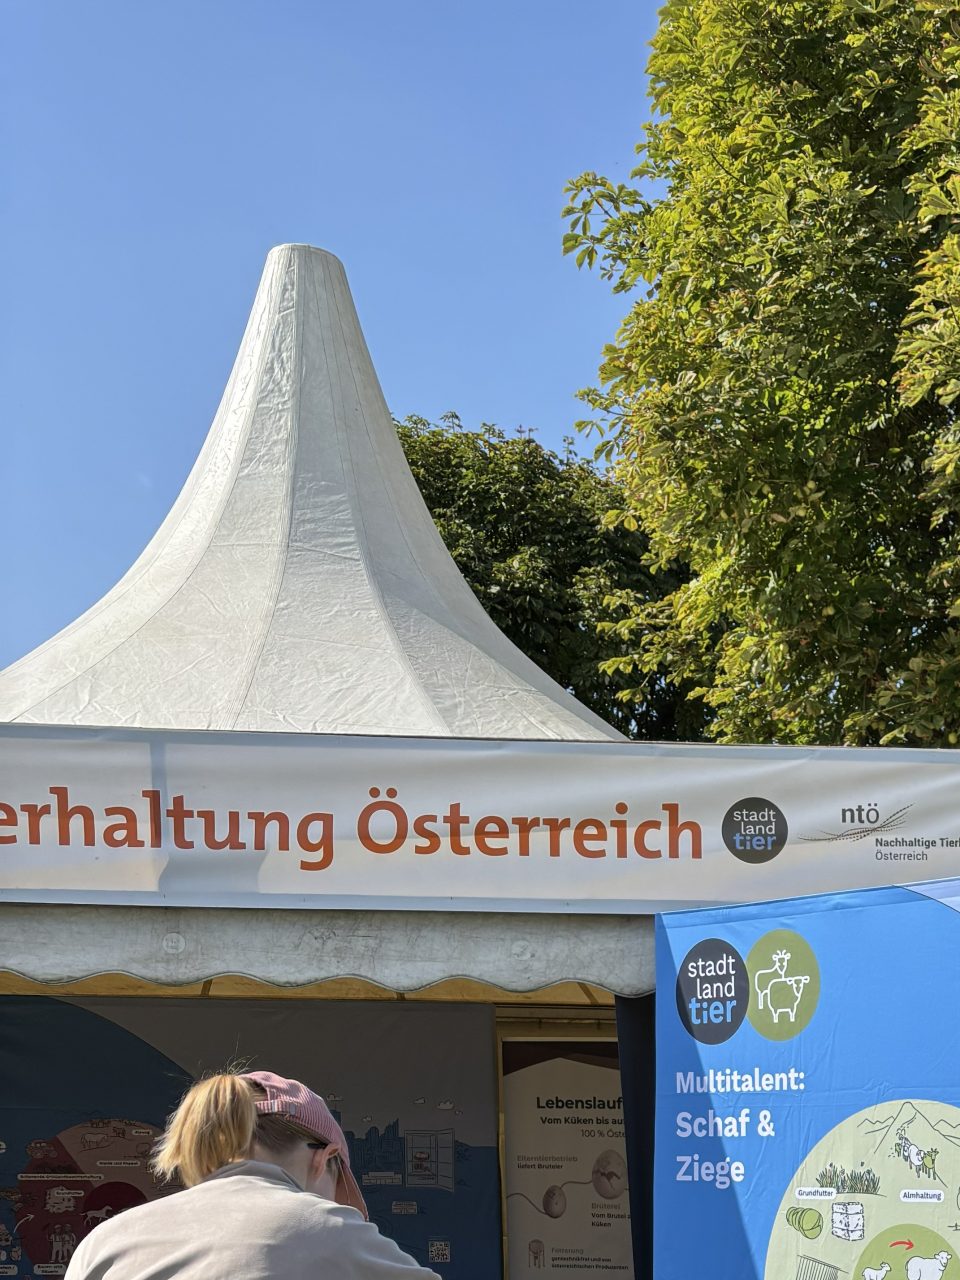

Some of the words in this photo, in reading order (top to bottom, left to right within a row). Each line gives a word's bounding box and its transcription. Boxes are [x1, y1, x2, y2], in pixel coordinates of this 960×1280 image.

[356, 786, 703, 860] Österreich
[733, 808, 776, 822] stadt
[841, 803, 880, 825] ntö
[740, 821, 776, 835] land
[733, 832, 777, 851] tier
[875, 837, 937, 850] Nachhaltige
[875, 849, 928, 861] Österreich
[688, 953, 736, 978] stadt
[696, 976, 736, 1000] land
[688, 997, 737, 1025] tier
[675, 1067, 806, 1094] Multitalent:
[536, 1095, 624, 1110] Lebenslauf
[540, 1116, 562, 1126] Vom
[563, 1115, 594, 1126] Küken
[595, 1115, 609, 1126] bis
[675, 1108, 750, 1138] Schaf
[757, 1109, 776, 1137] &
[675, 1155, 745, 1190] Ziege
[798, 1188, 834, 1198] Grundfutter
[902, 1191, 942, 1201] Almhaltung
